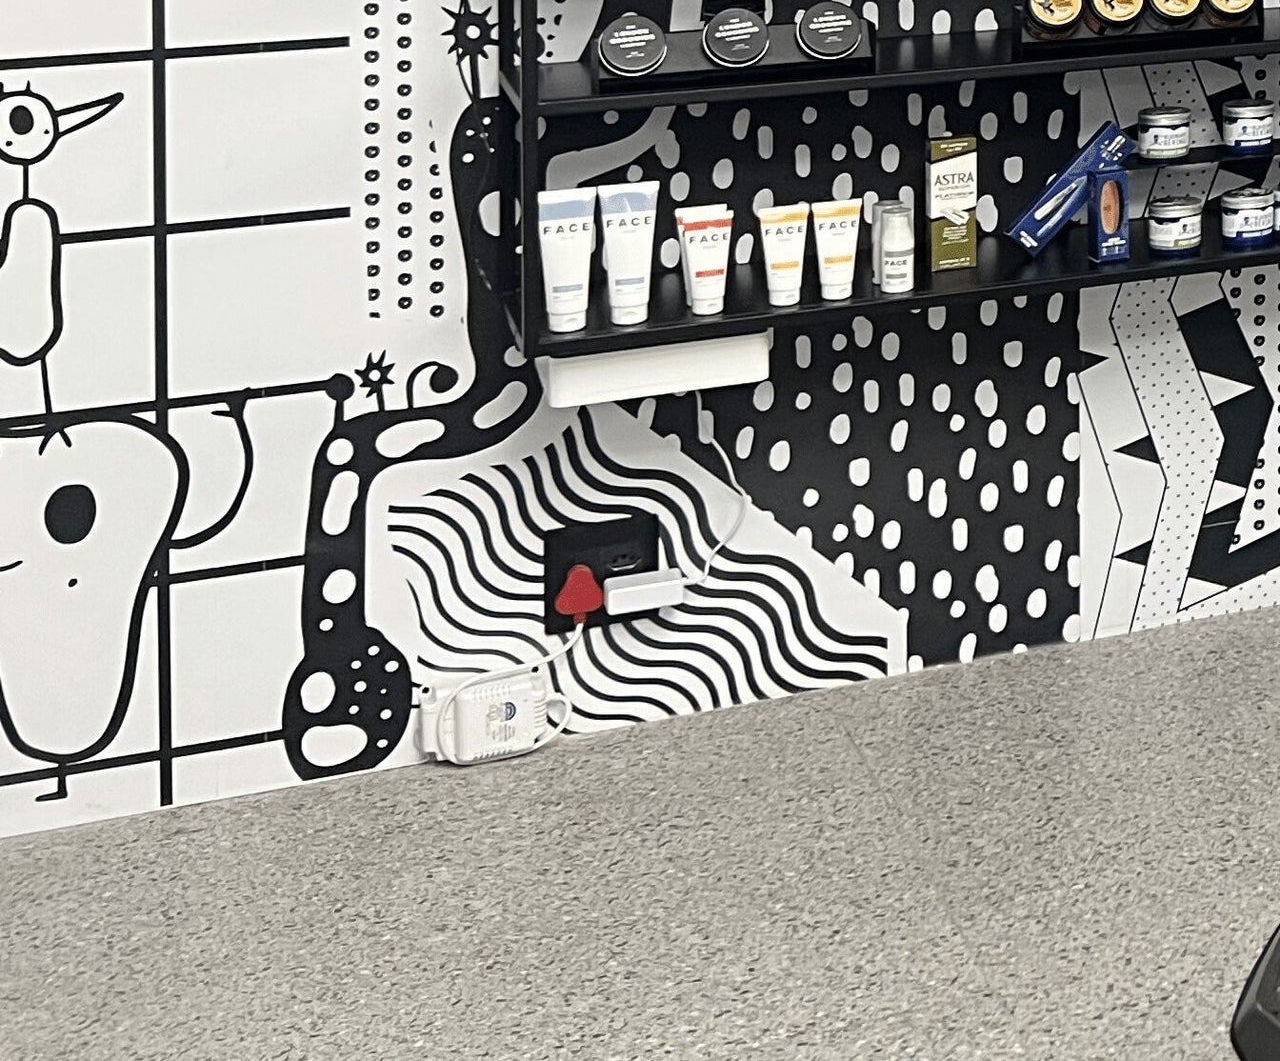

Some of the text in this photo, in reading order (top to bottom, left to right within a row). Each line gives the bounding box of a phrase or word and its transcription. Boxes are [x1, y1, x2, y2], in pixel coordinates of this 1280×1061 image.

[934, 172, 974, 187] ASTRA
[606, 216, 652, 228] FACE
[818, 220, 858, 231] FACE
[543, 222, 590, 235] FACE
[765, 225, 803, 237] FACE
[689, 232, 729, 244] FACE
